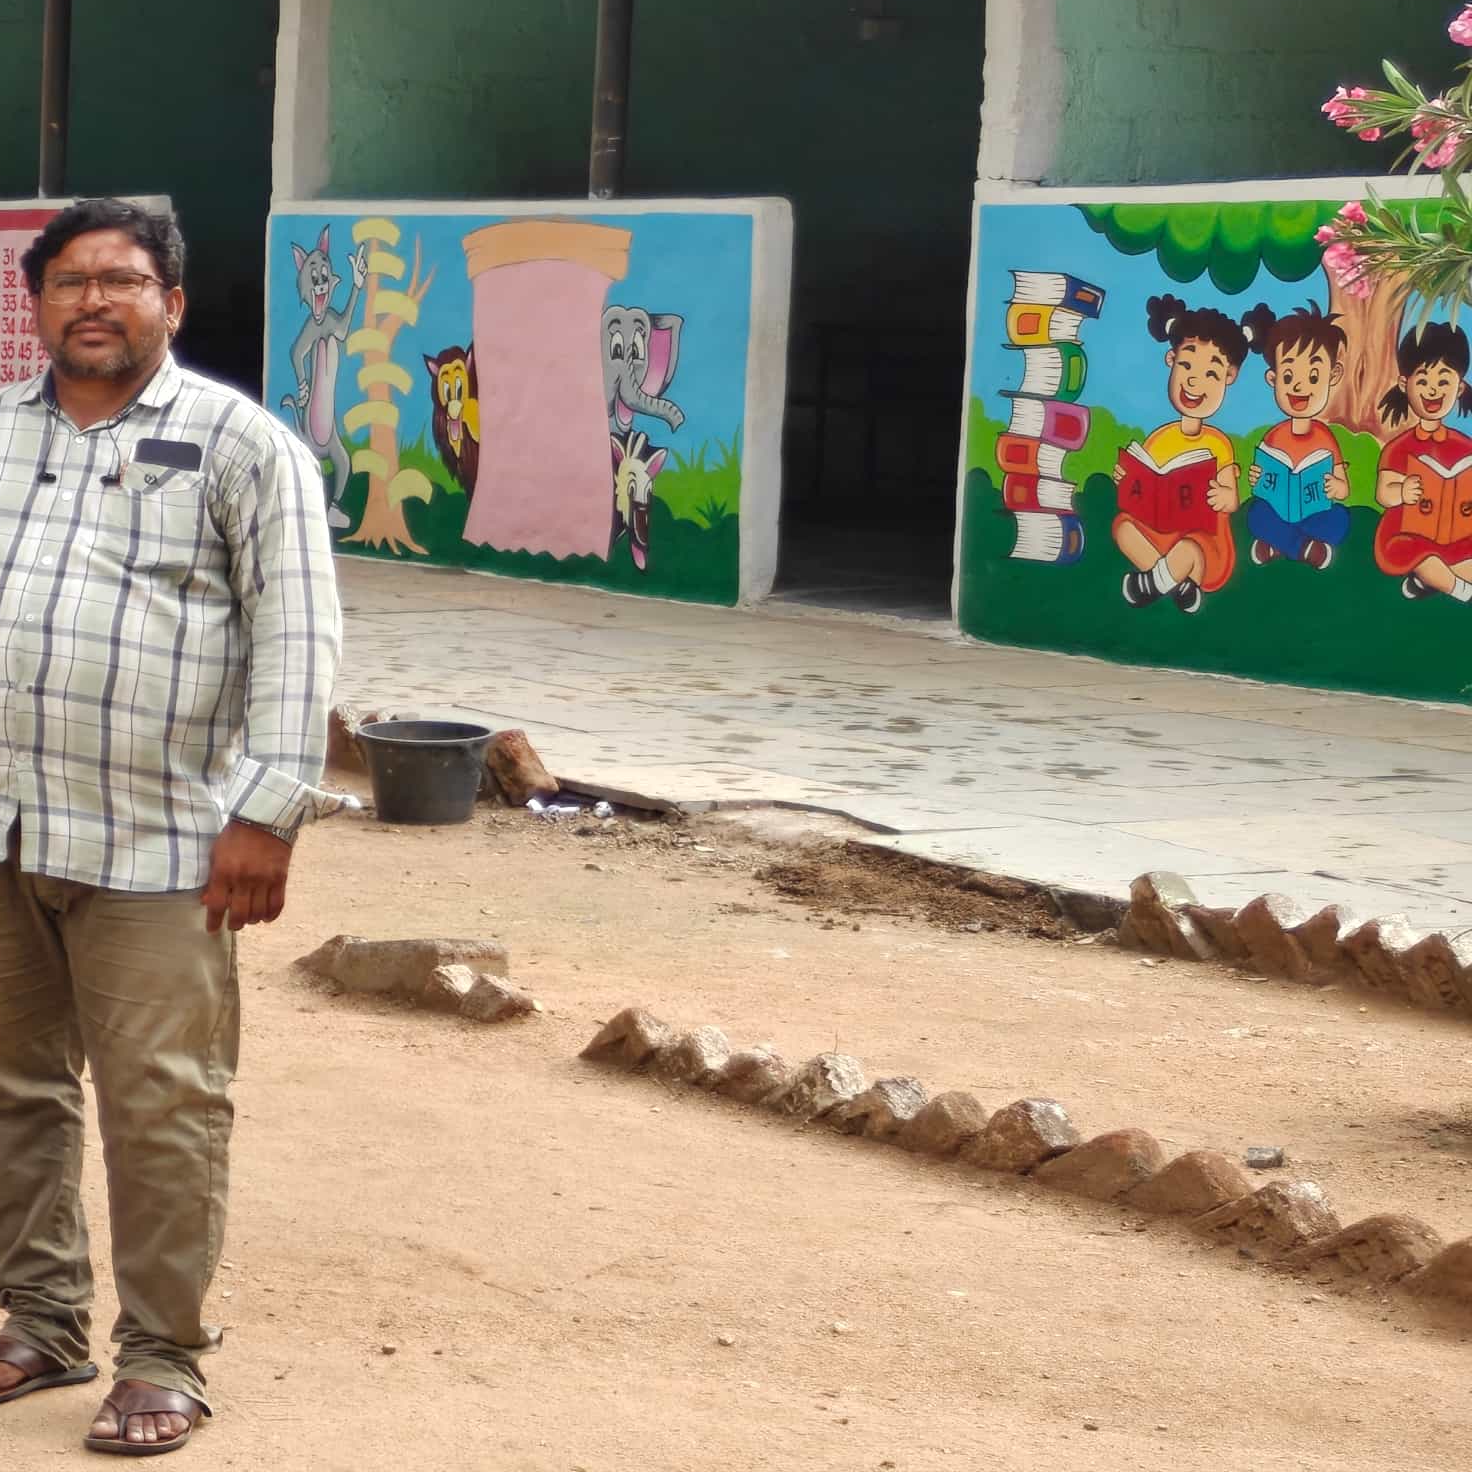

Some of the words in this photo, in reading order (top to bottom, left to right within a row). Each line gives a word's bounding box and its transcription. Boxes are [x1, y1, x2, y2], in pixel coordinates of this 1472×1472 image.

[3, 247, 14, 265] 31
[2, 270, 17, 288] 32
[2, 294, 17, 312] 33
[2, 317, 15, 336] 34
[0, 340, 15, 360] 35
[18, 341, 33, 361] 45
[0, 364, 15, 383] 36
[1129, 480, 1142, 501] A
[1179, 484, 1193, 510] B
[1263, 472, 1278, 491] अ
[1304, 481, 1320, 504] आ
